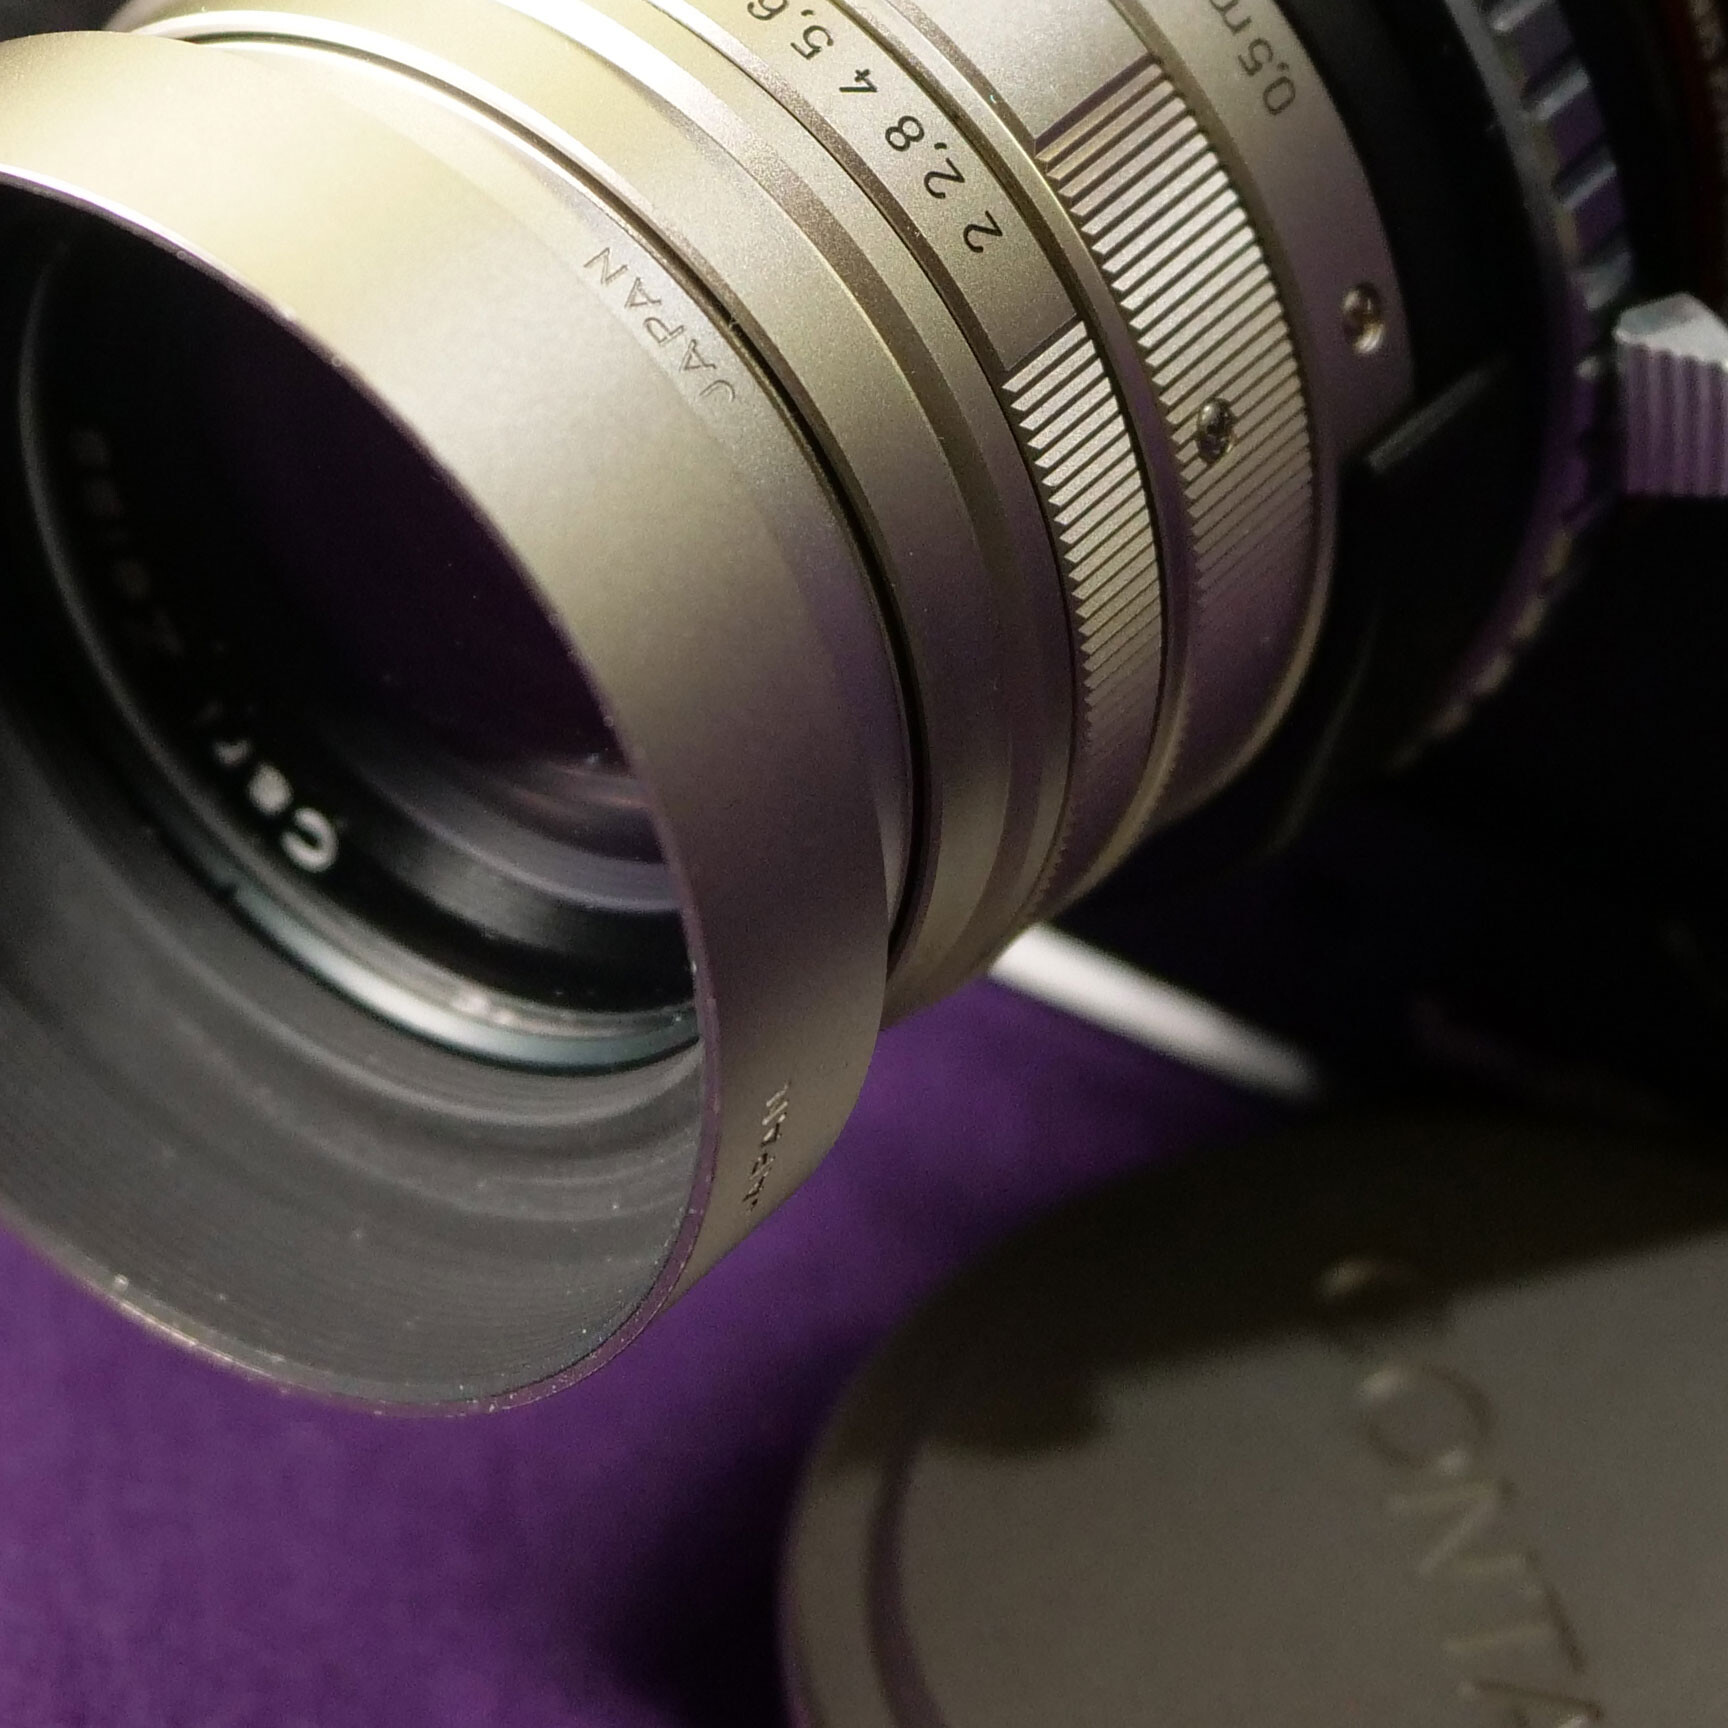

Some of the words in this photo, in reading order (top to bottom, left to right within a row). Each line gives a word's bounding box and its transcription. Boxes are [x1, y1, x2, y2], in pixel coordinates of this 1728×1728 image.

[839, 68, 878, 94] 4
[885, 115, 966, 199] 2,8
[963, 210, 1004, 254] 2
[584, 247, 736, 403] JAPAN
